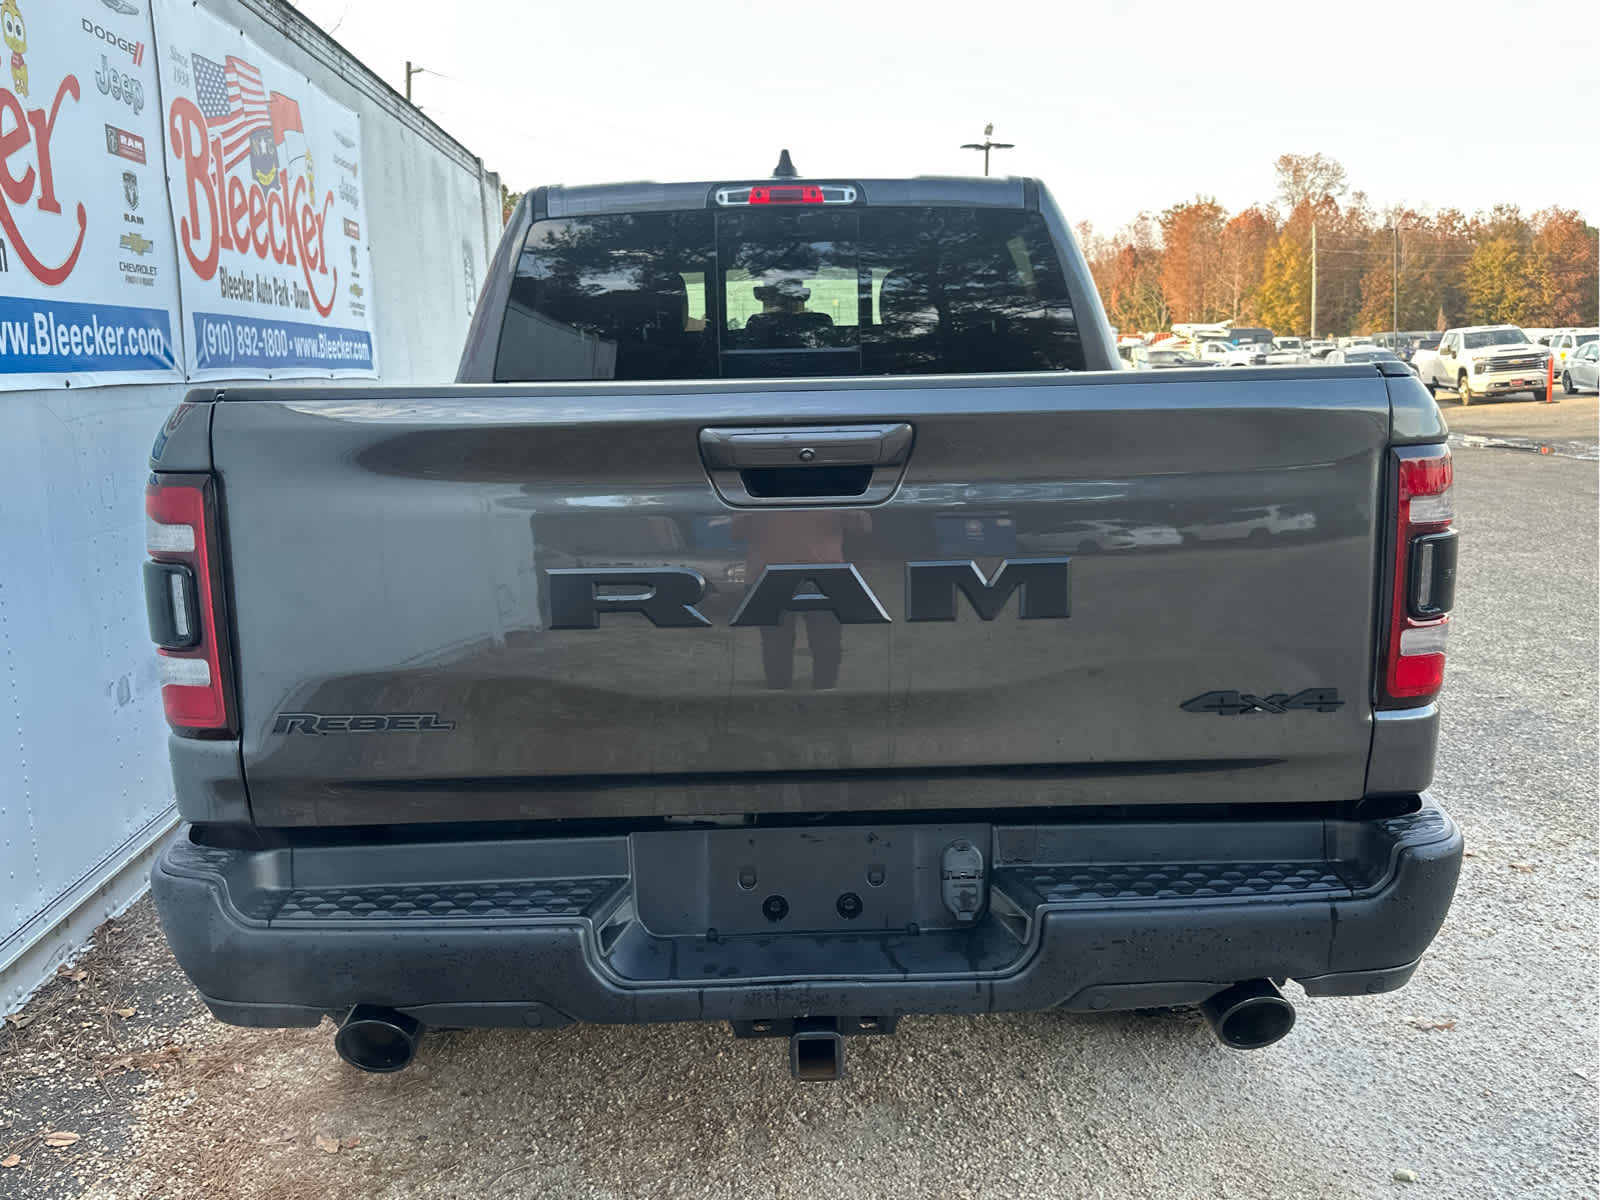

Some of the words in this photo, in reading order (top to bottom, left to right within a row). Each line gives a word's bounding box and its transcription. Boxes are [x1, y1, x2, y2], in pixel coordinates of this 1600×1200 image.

[82, 18, 137, 55] DODGE
[96, 54, 144, 115] Jeep
[120, 134, 143, 151] RAM
[124, 213, 144, 224] RAM
[166, 97, 336, 318] Bleecker
[119, 261, 157, 276] CHEVROLET
[219, 266, 254, 302] Bleecker
[256, 273, 272, 304] Auto
[273, 276, 289, 308] Park
[203, 319, 235, 362] (910)
[237, 325, 288, 357] 892-1800
[294, 333, 370, 361] www.Bleecker.com
[545, 557, 1072, 629] RAM
[272, 712, 456, 736] REBEL
